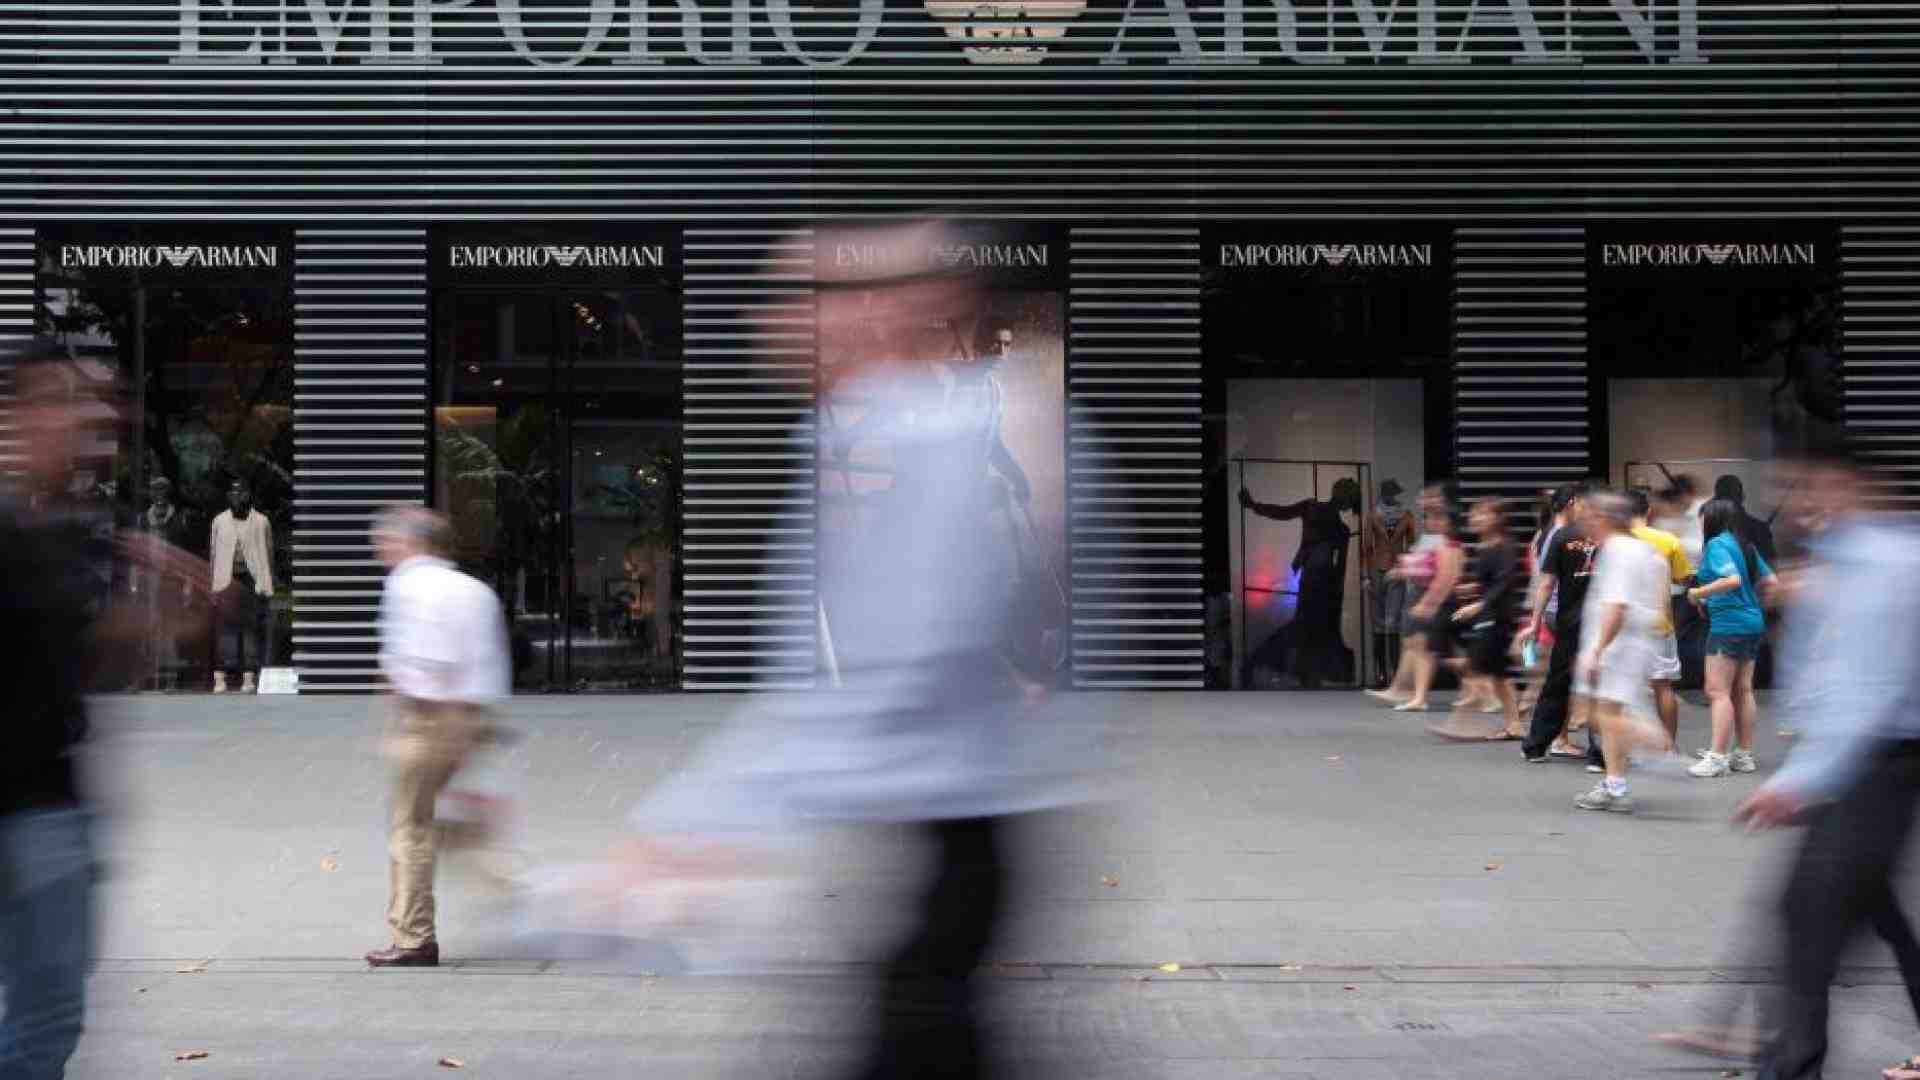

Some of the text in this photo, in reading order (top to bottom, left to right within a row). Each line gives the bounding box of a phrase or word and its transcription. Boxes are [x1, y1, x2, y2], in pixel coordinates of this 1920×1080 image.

[61, 246, 277, 266] EMPORIO ARMANI
[450, 246, 663, 266] EMPORIO ARMANI
[964, 245, 1048, 266] ARMANI
[1220, 245, 1431, 266] EMPORIO ARMANI
[1603, 244, 1815, 264] EMPORIO ARMANI
